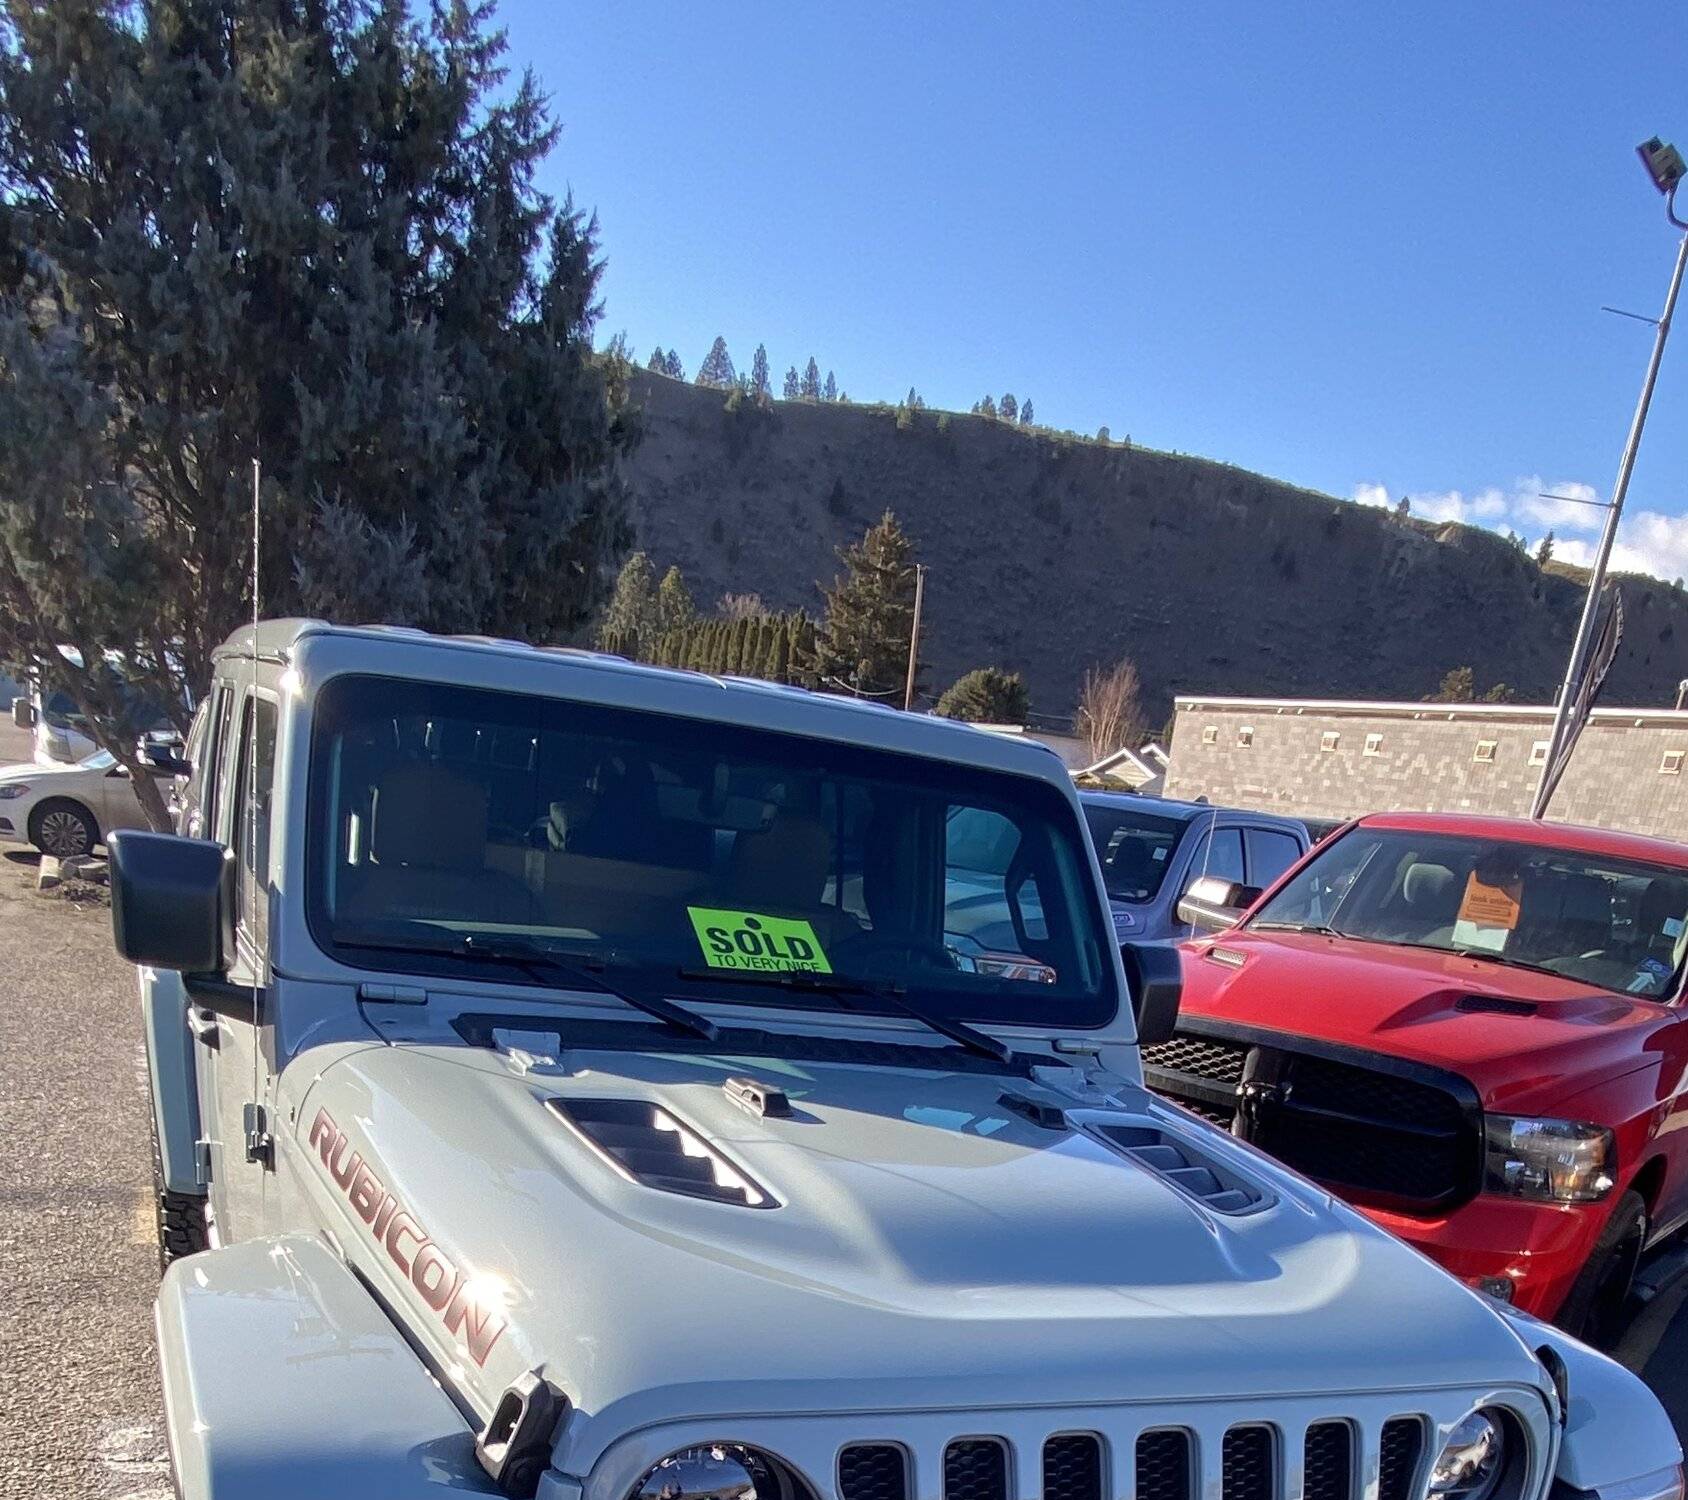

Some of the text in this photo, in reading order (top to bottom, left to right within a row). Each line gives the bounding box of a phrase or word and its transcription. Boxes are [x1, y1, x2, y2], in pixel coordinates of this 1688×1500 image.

[706, 927, 814, 960] SOLD
[713, 954, 737, 967] TO
[739, 956, 781, 970] VERY
[309, 1106, 508, 1369] RUBICON
